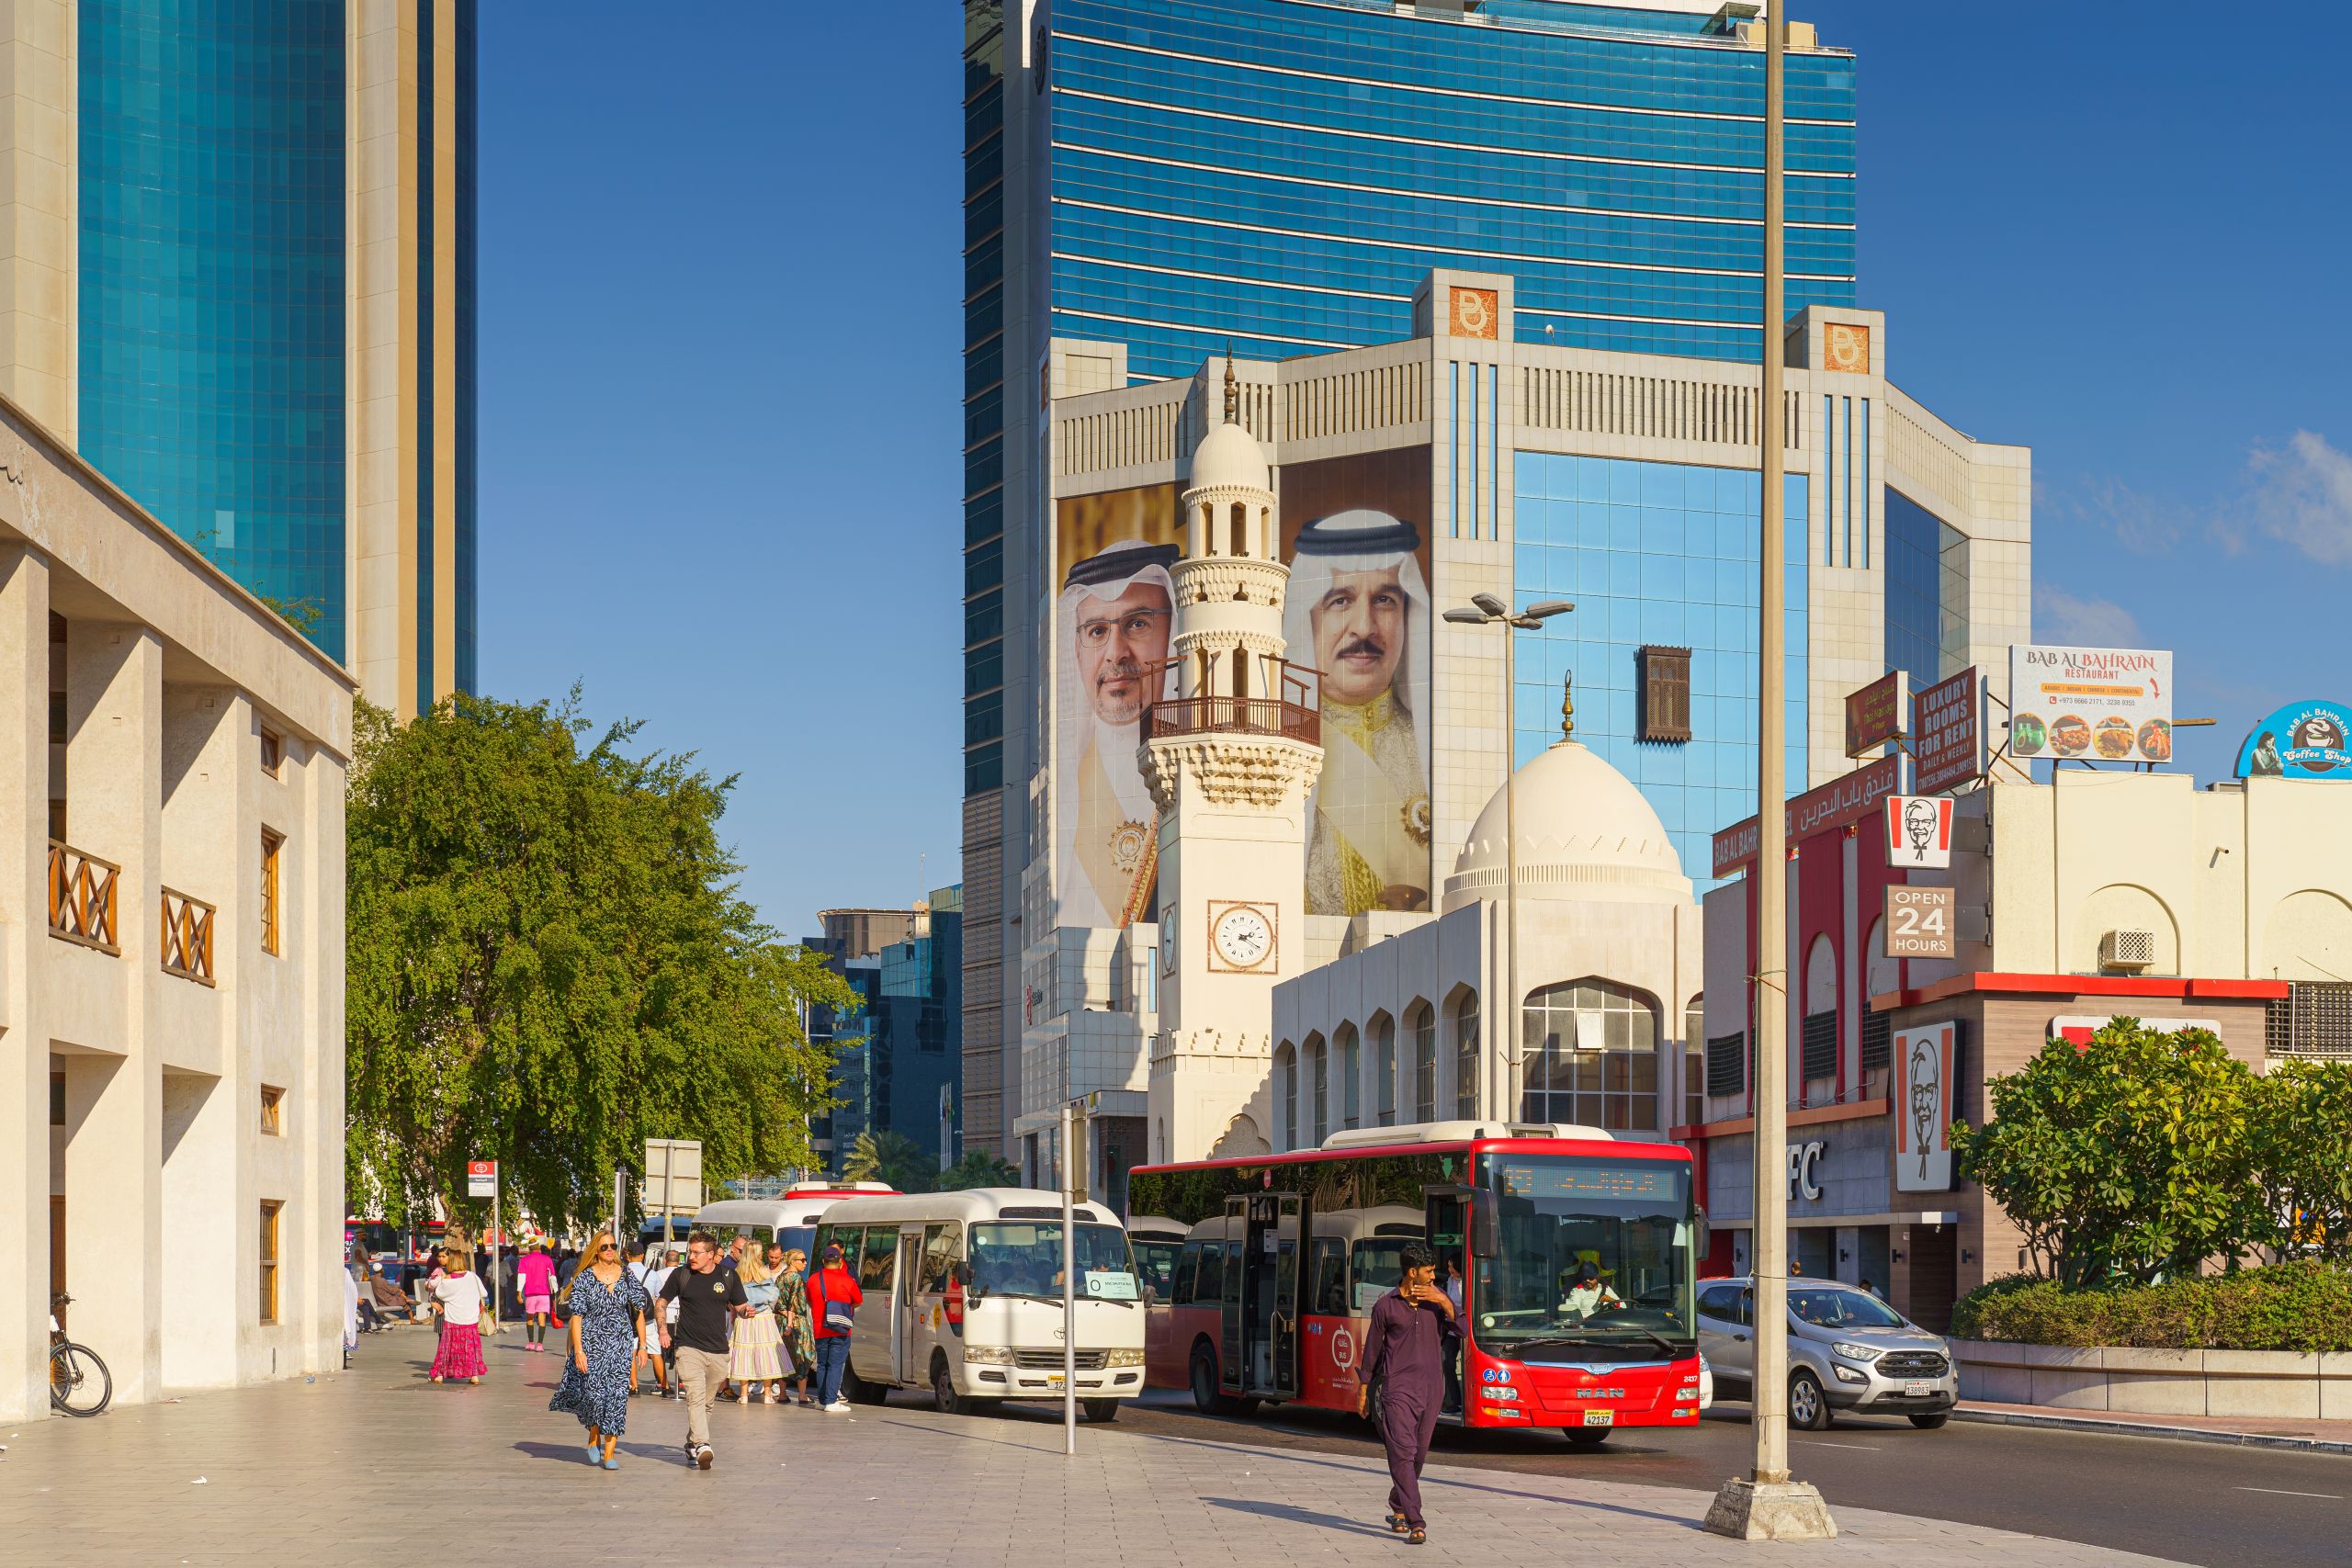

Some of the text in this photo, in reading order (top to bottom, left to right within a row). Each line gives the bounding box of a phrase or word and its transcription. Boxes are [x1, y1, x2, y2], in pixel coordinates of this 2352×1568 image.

[2026, 651, 2158, 671] BAB AL BAHRAIN
[2064, 669, 2120, 680] RESTAURANT
[1923, 676, 1969, 715] LUXURY
[1925, 699, 1968, 735] ROOMS
[2287, 708, 2350, 737] BAB AL BAHRAIN
[1918, 717, 1974, 759] FOR RENT
[1923, 755, 1939, 772] DAILY
[1947, 741, 1970, 761] WEEKLY
[2283, 750, 2352, 764] Coffee Shop
[1842, 780, 1861, 812] باب
[1864, 765, 1894, 806] فندق
[1800, 787, 1840, 831] البحرين
[1714, 826, 1758, 867] BAB AL BAHR
[1895, 892, 1945, 905] OPEN
[1895, 907, 1945, 936] 24
[1895, 939, 1947, 952] HOURS
[1786, 1141, 1823, 1201] FC
[1576, 1388, 1624, 1398] MAN
[1587, 1416, 1610, 1425] 42137
